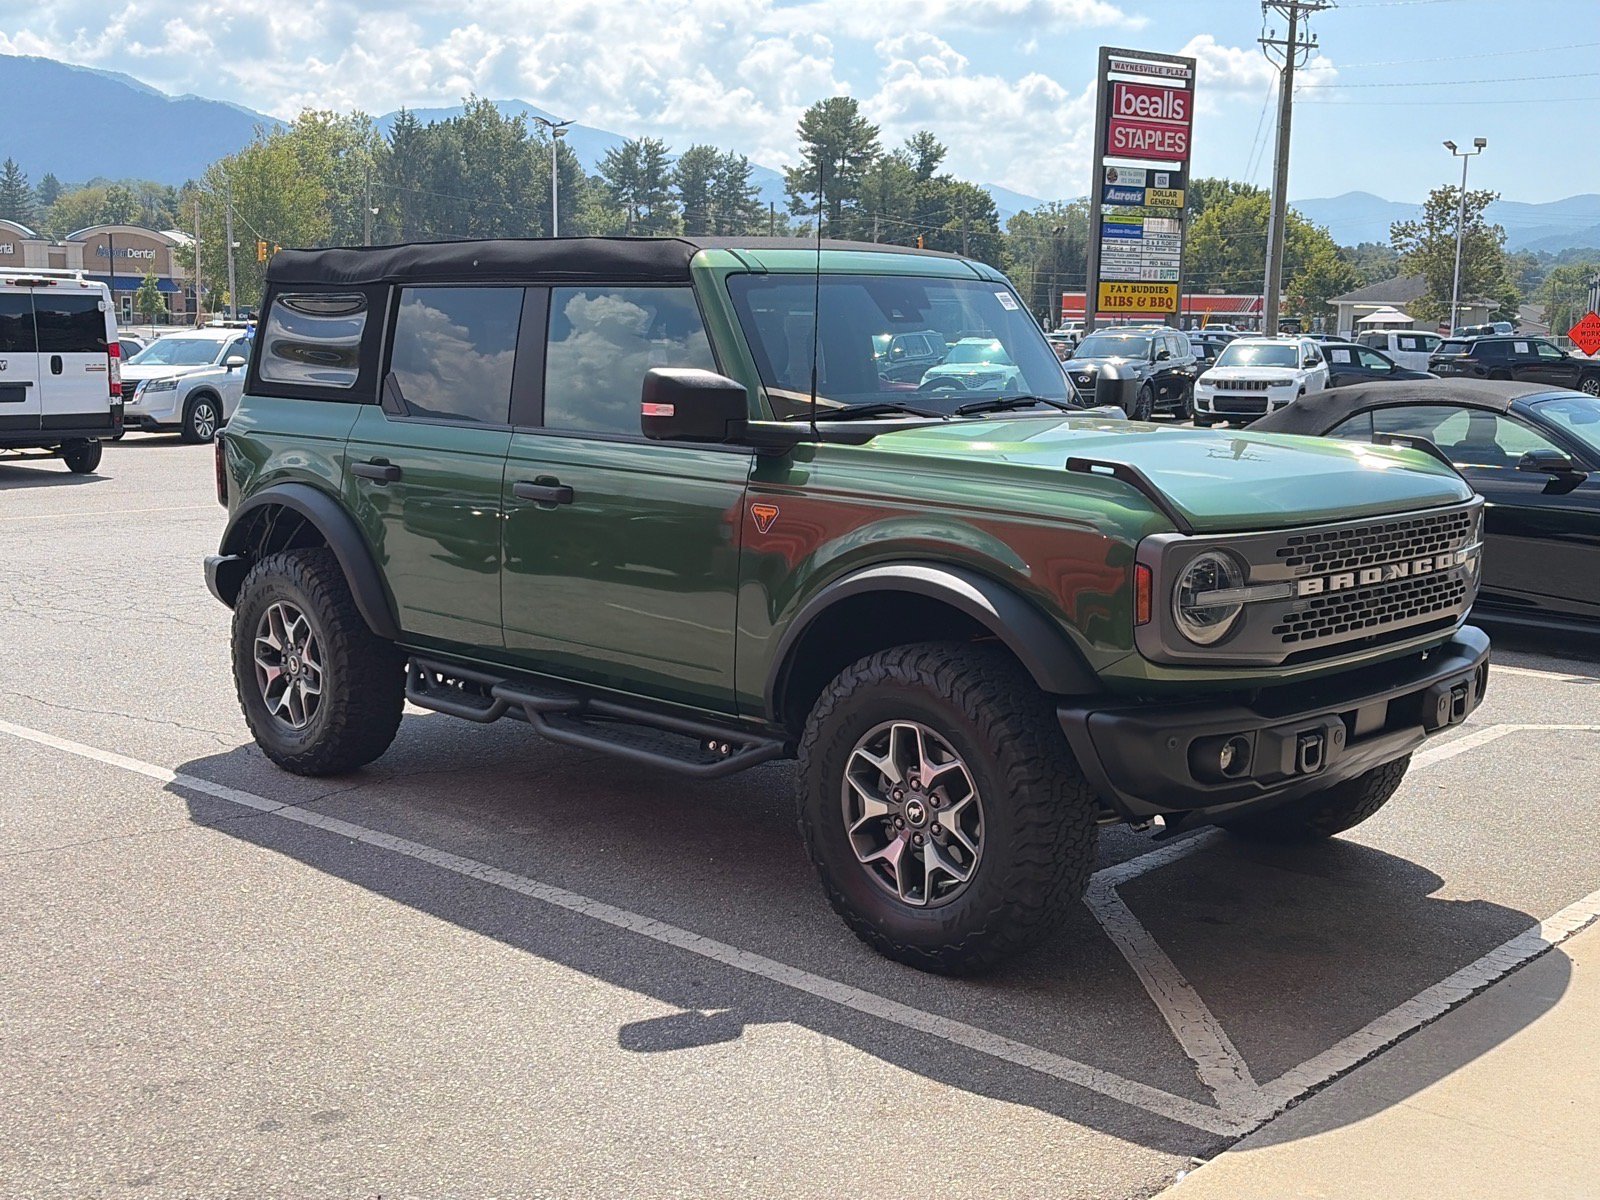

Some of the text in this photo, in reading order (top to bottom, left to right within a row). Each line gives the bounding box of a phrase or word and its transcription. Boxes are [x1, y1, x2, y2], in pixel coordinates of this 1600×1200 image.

[1114, 62, 1188, 77] WAYNESVILLE PLAZA
[1120, 86, 1184, 119] bealls
[1114, 126, 1186, 153] STAPLES
[1106, 188, 1144, 201] Aaron's
[1152, 189, 1178, 198] DOLLAR
[1150, 197, 1178, 206] GENERAL
[1110, 285, 1169, 294] FAT BUDDIES
[1104, 295, 1173, 309] RIBS & BBQ
[1297, 554, 1454, 596] BRONCO
